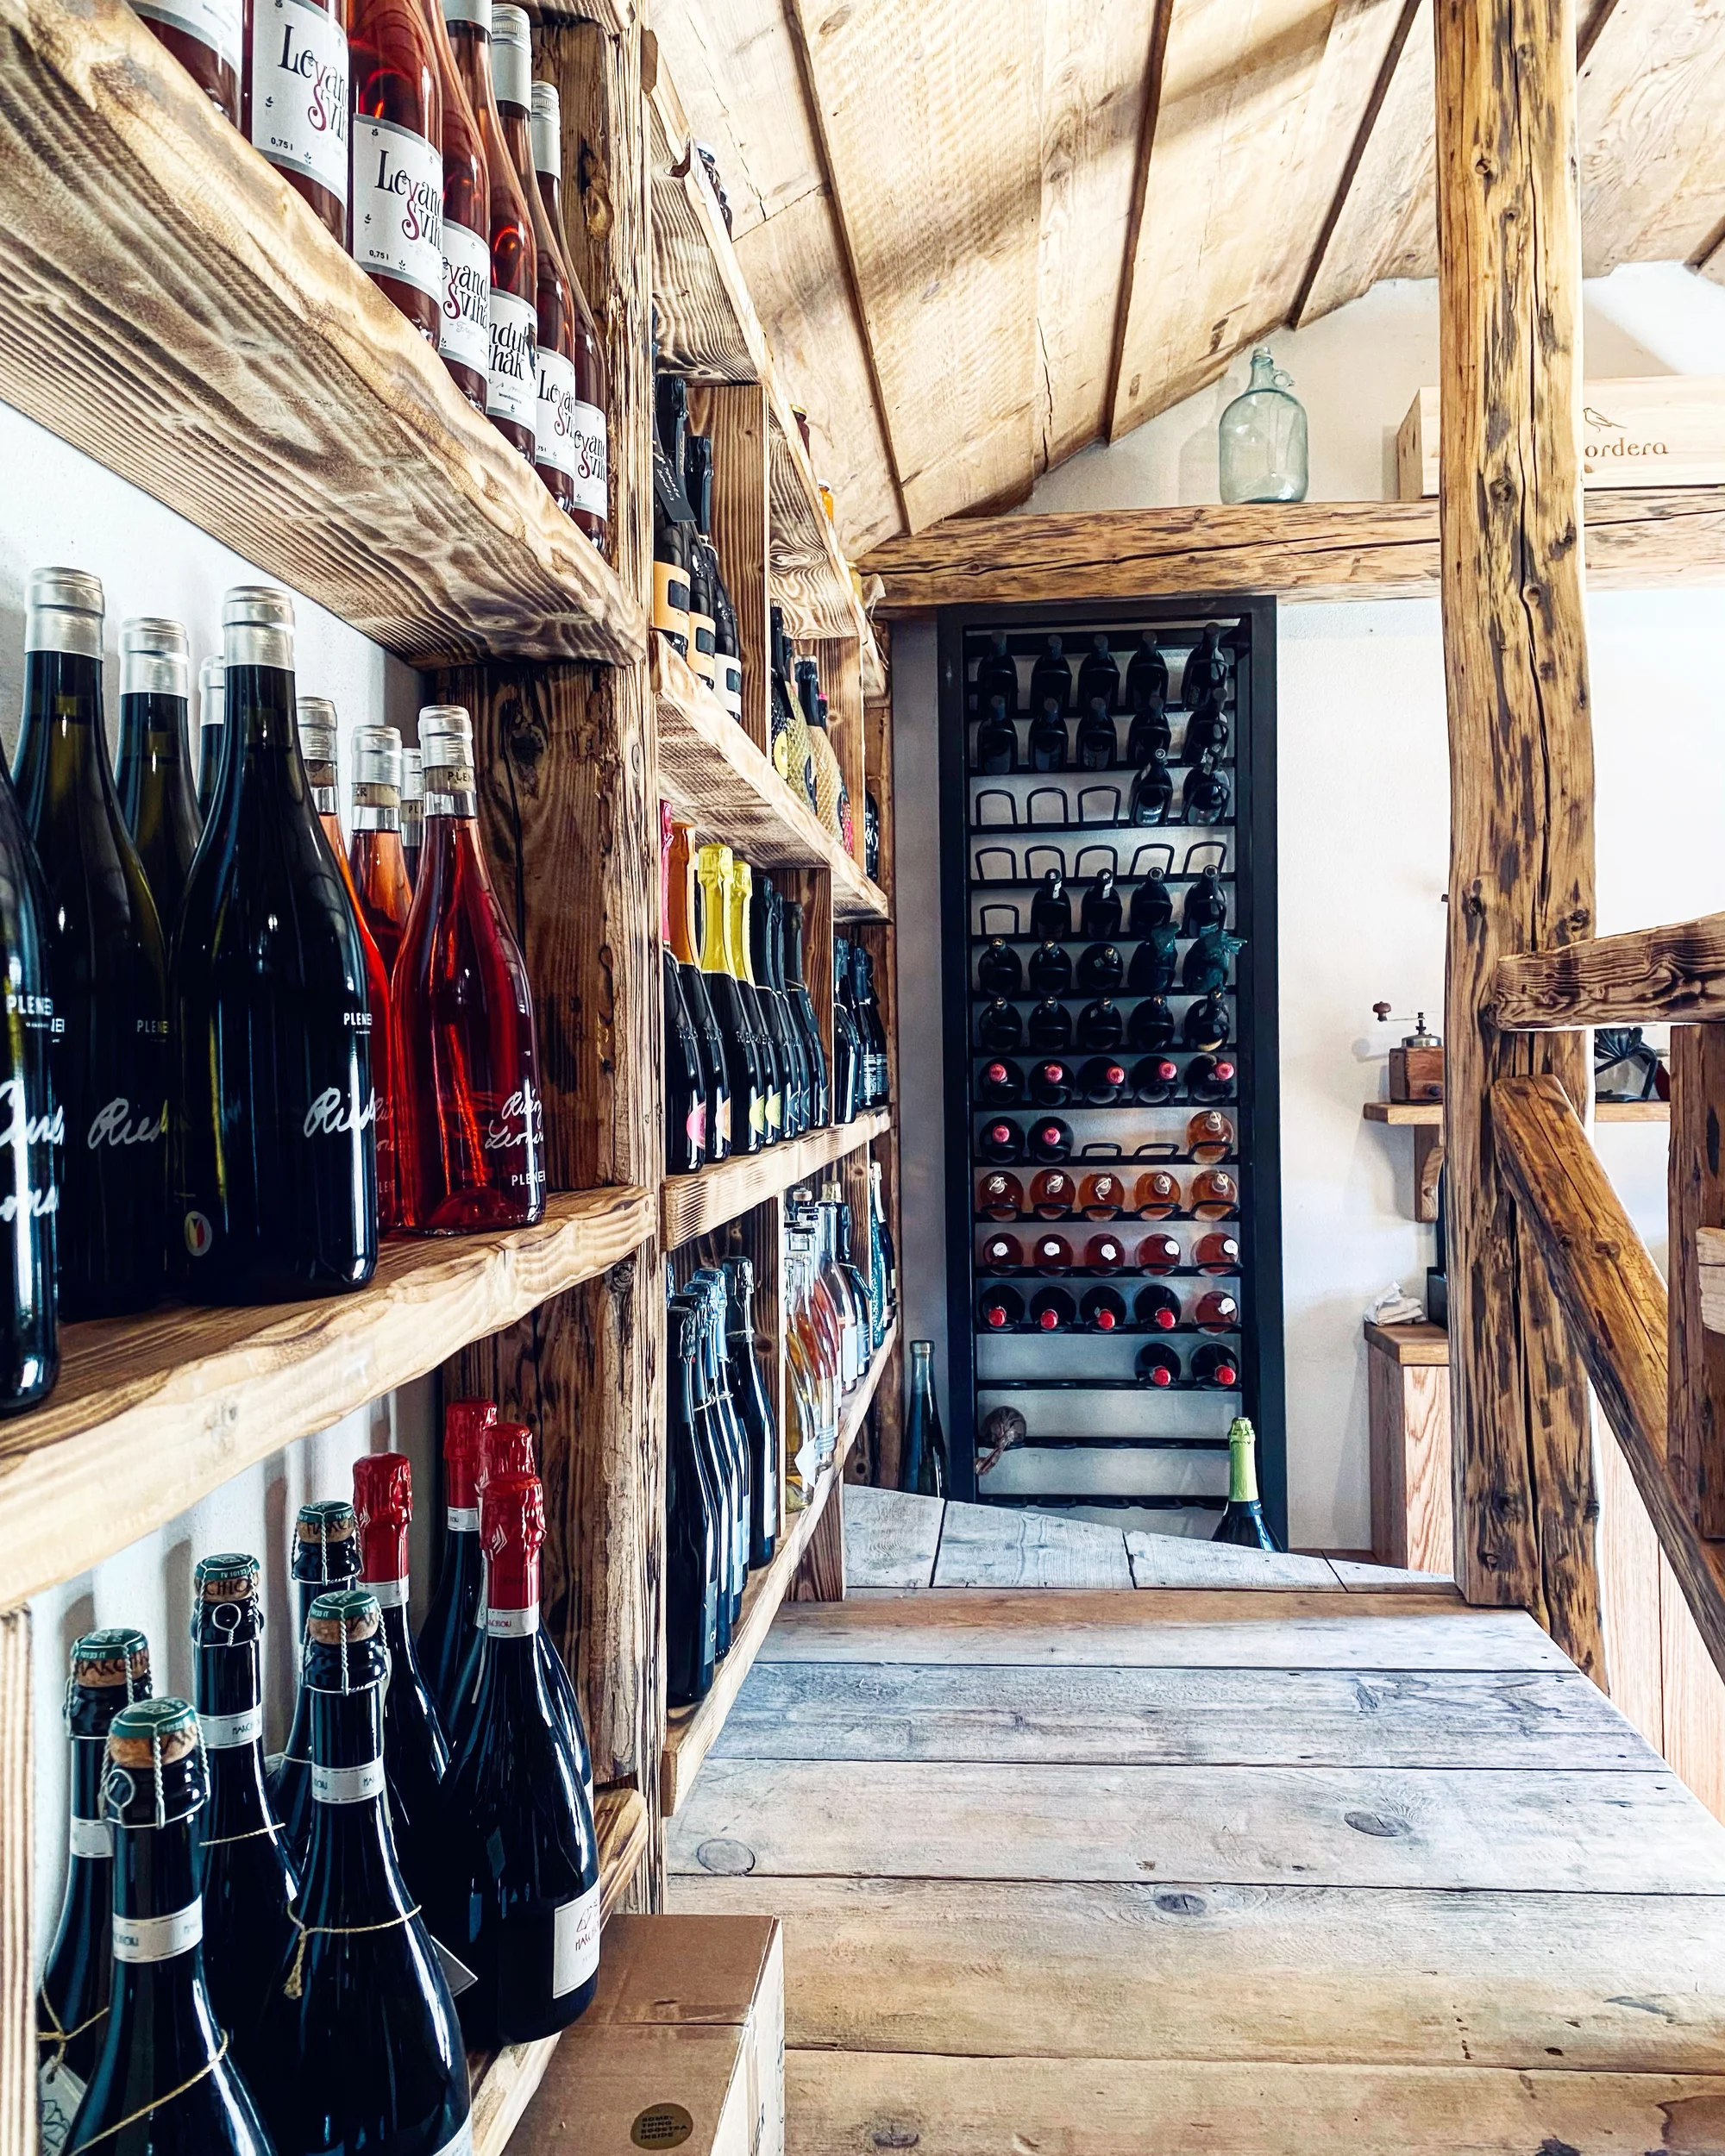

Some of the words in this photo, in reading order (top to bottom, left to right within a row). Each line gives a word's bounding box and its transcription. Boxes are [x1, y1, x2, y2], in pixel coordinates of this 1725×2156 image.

[271, 136, 288, 148] 0,75
[369, 249, 385, 259] 0,75
[1584, 437, 1669, 457] ordera
